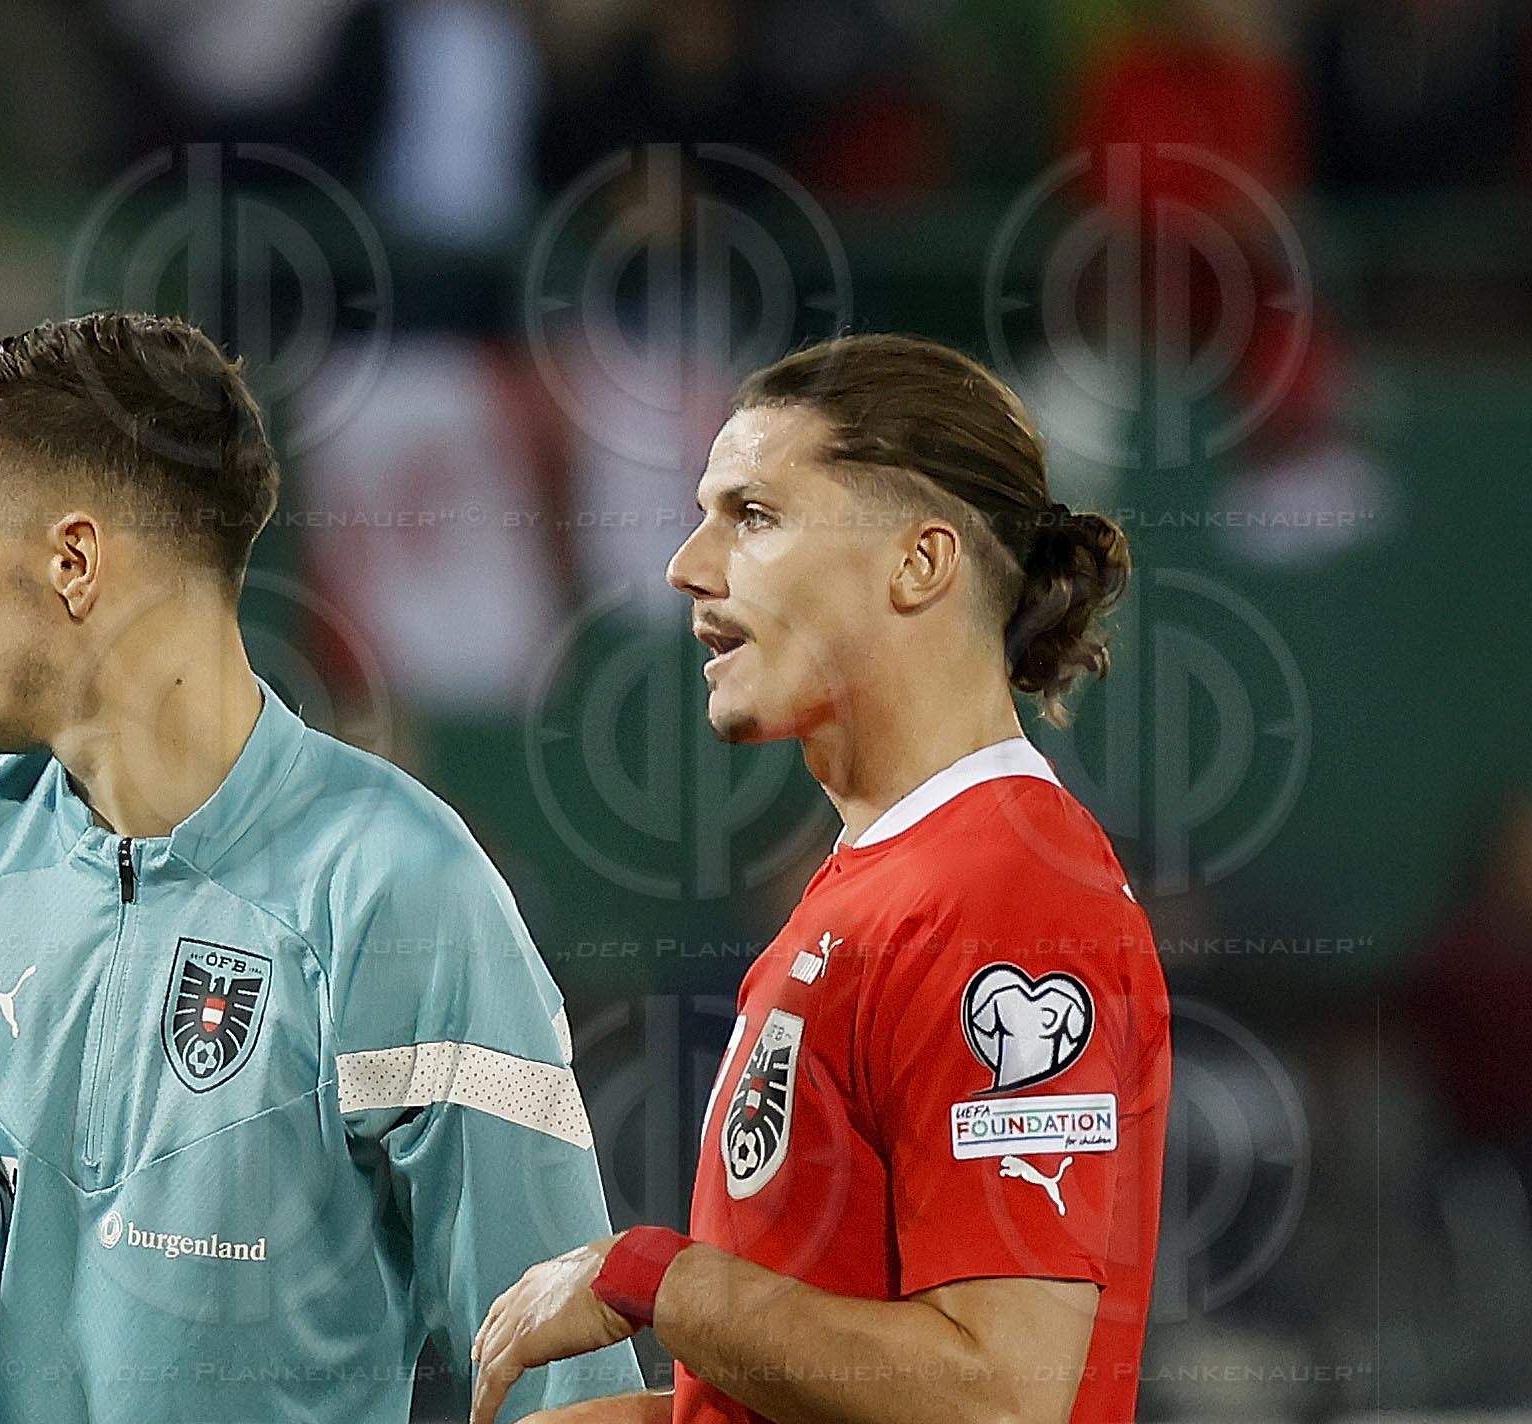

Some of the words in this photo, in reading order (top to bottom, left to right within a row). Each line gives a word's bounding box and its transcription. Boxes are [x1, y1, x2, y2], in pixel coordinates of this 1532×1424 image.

[206, 952, 247, 973] ÖFB
[956, 1105, 991, 1119] UEFA
[956, 1113, 1112, 1140] FOUNDATION
[127, 1221, 267, 1261] burgenland
